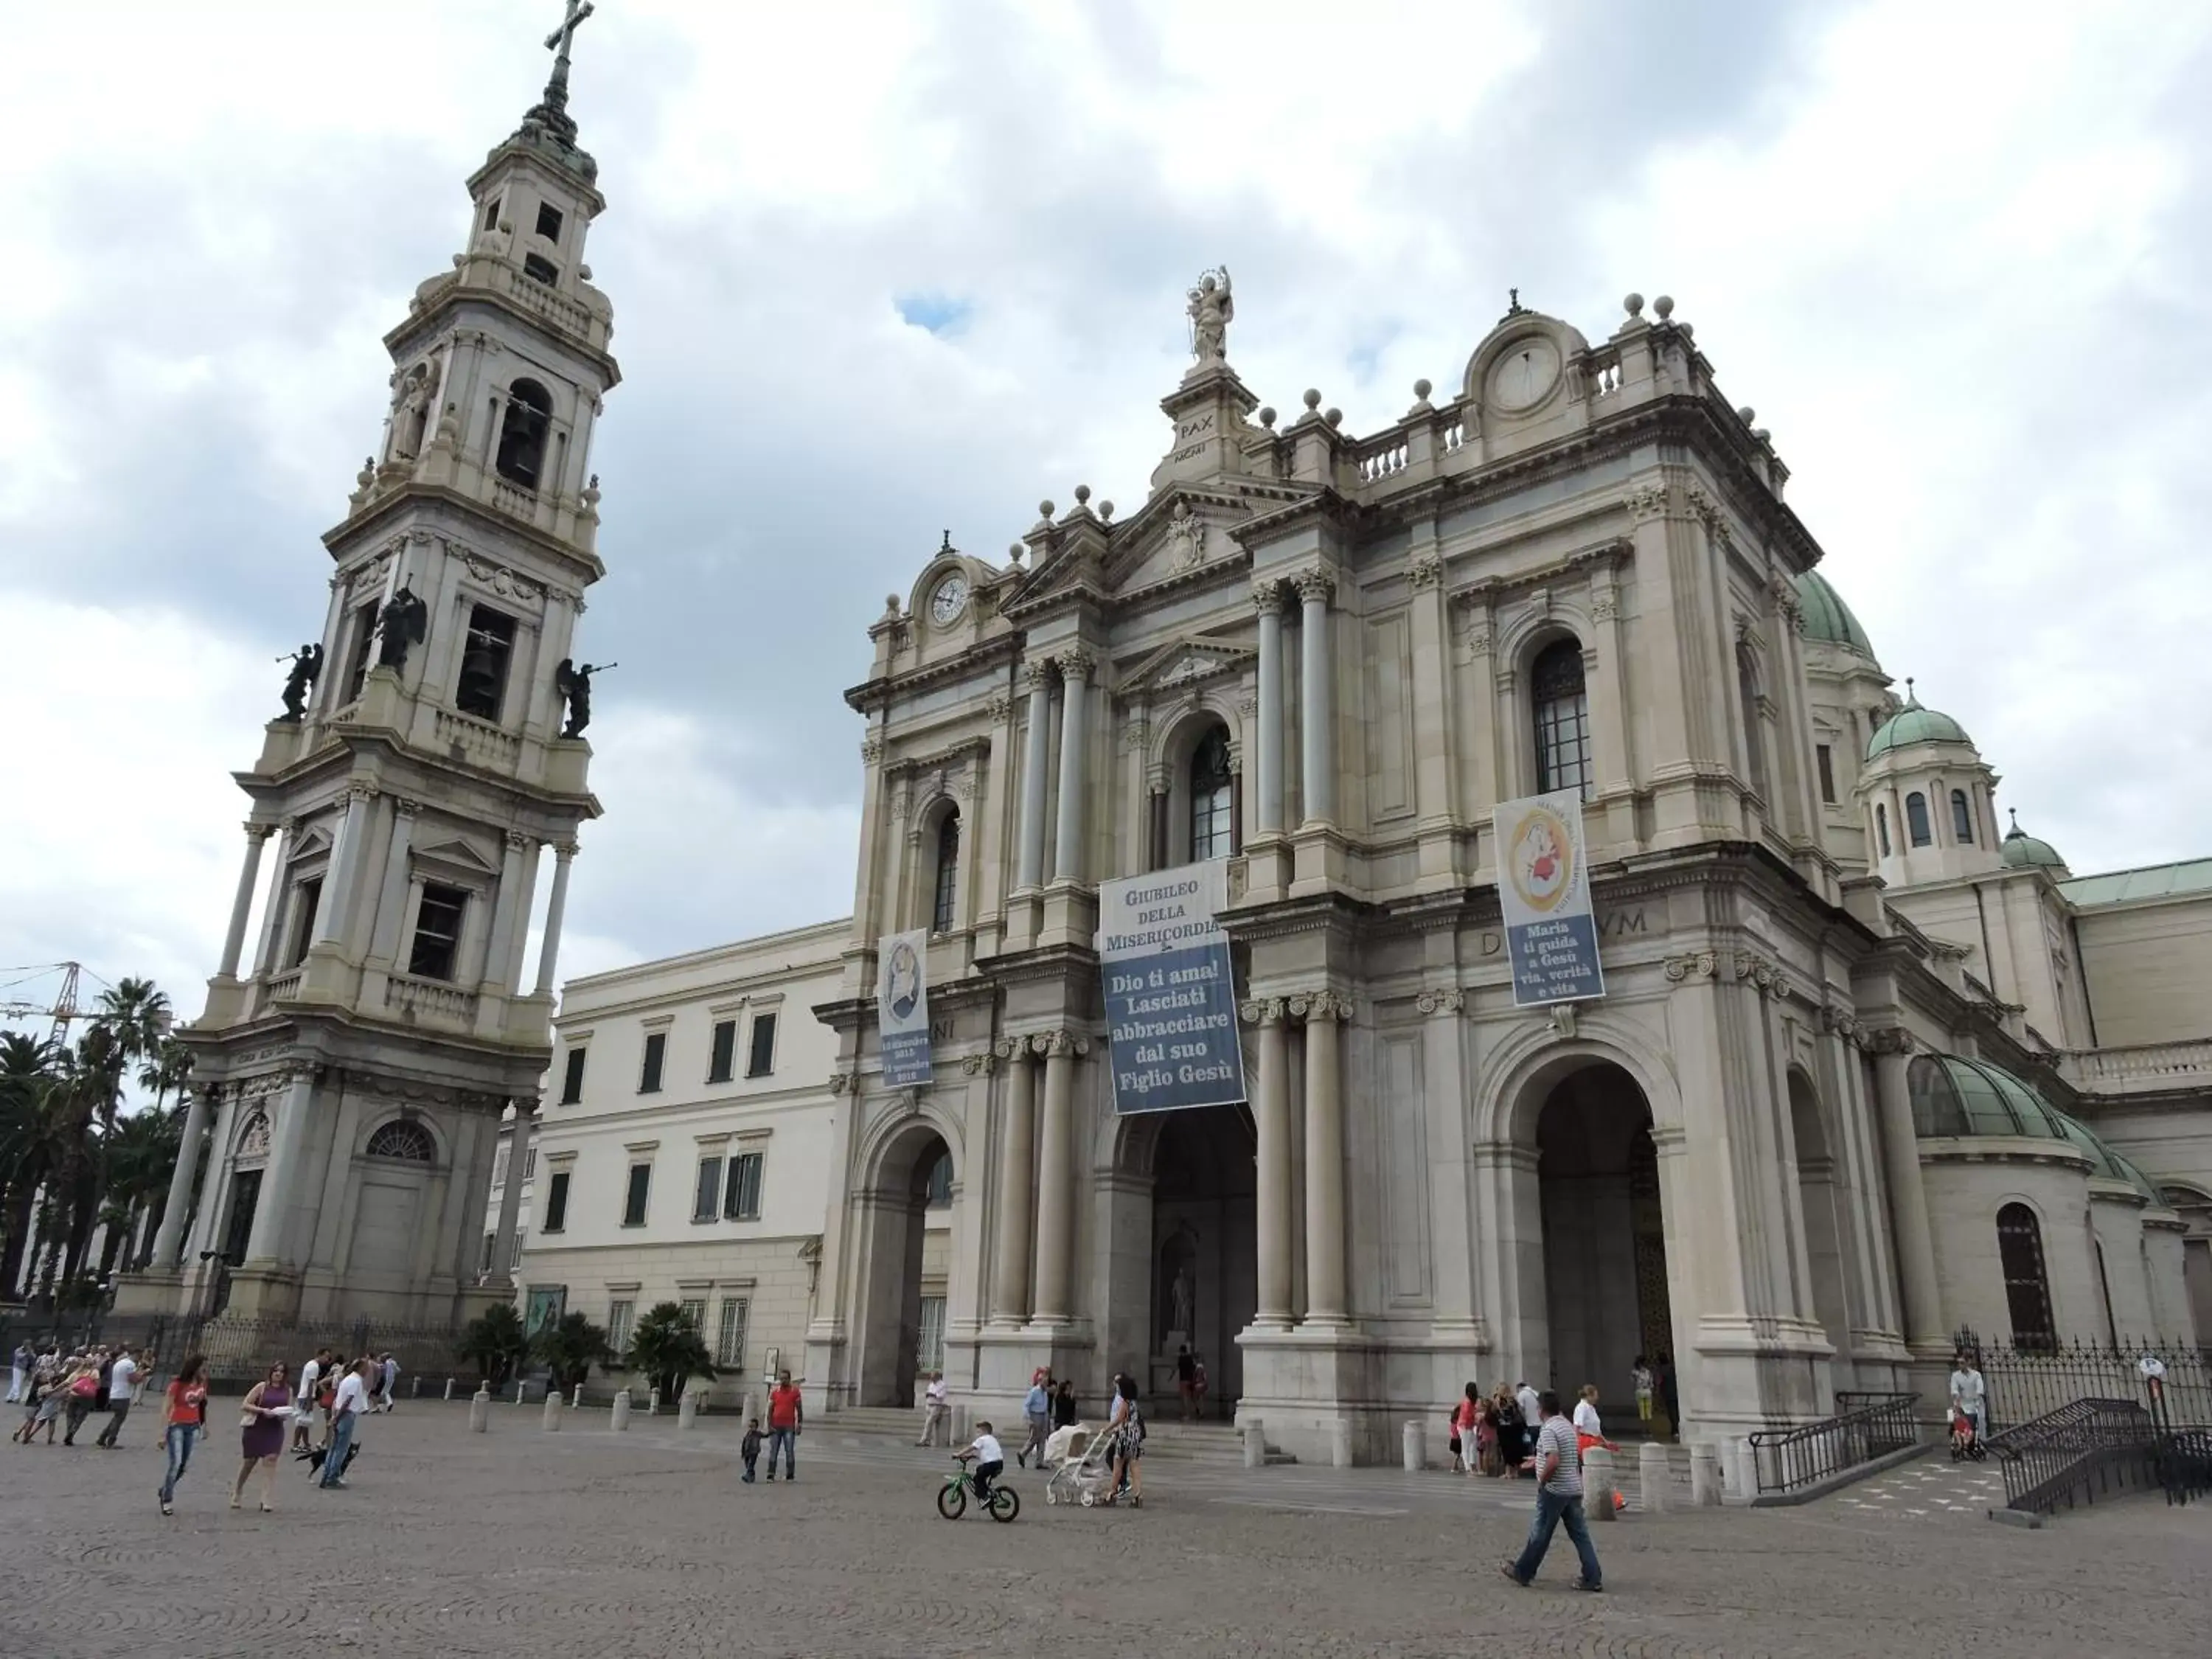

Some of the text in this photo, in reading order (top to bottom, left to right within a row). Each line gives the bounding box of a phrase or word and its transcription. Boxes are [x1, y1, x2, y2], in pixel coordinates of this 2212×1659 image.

[1181, 414, 1213, 440] PAX
[1125, 880, 1198, 906] GIUBILEO
[1138, 905, 1186, 925] DELLA
[1106, 919, 1222, 952] MISERICORDIA
[1527, 922, 1570, 939] Maria
[1538, 936, 1579, 955] guida
[1111, 959, 1218, 994] Dio ti ama!
[1528, 959, 1538, 969] a
[1127, 986, 1207, 1015] Lasciati
[1113, 1012, 1228, 1042] abbracciare
[1135, 1042, 1207, 1064] dal suo
[1119, 1059, 1234, 1093] Figlio Gesù
[2144, 1359, 2157, 1369] P
